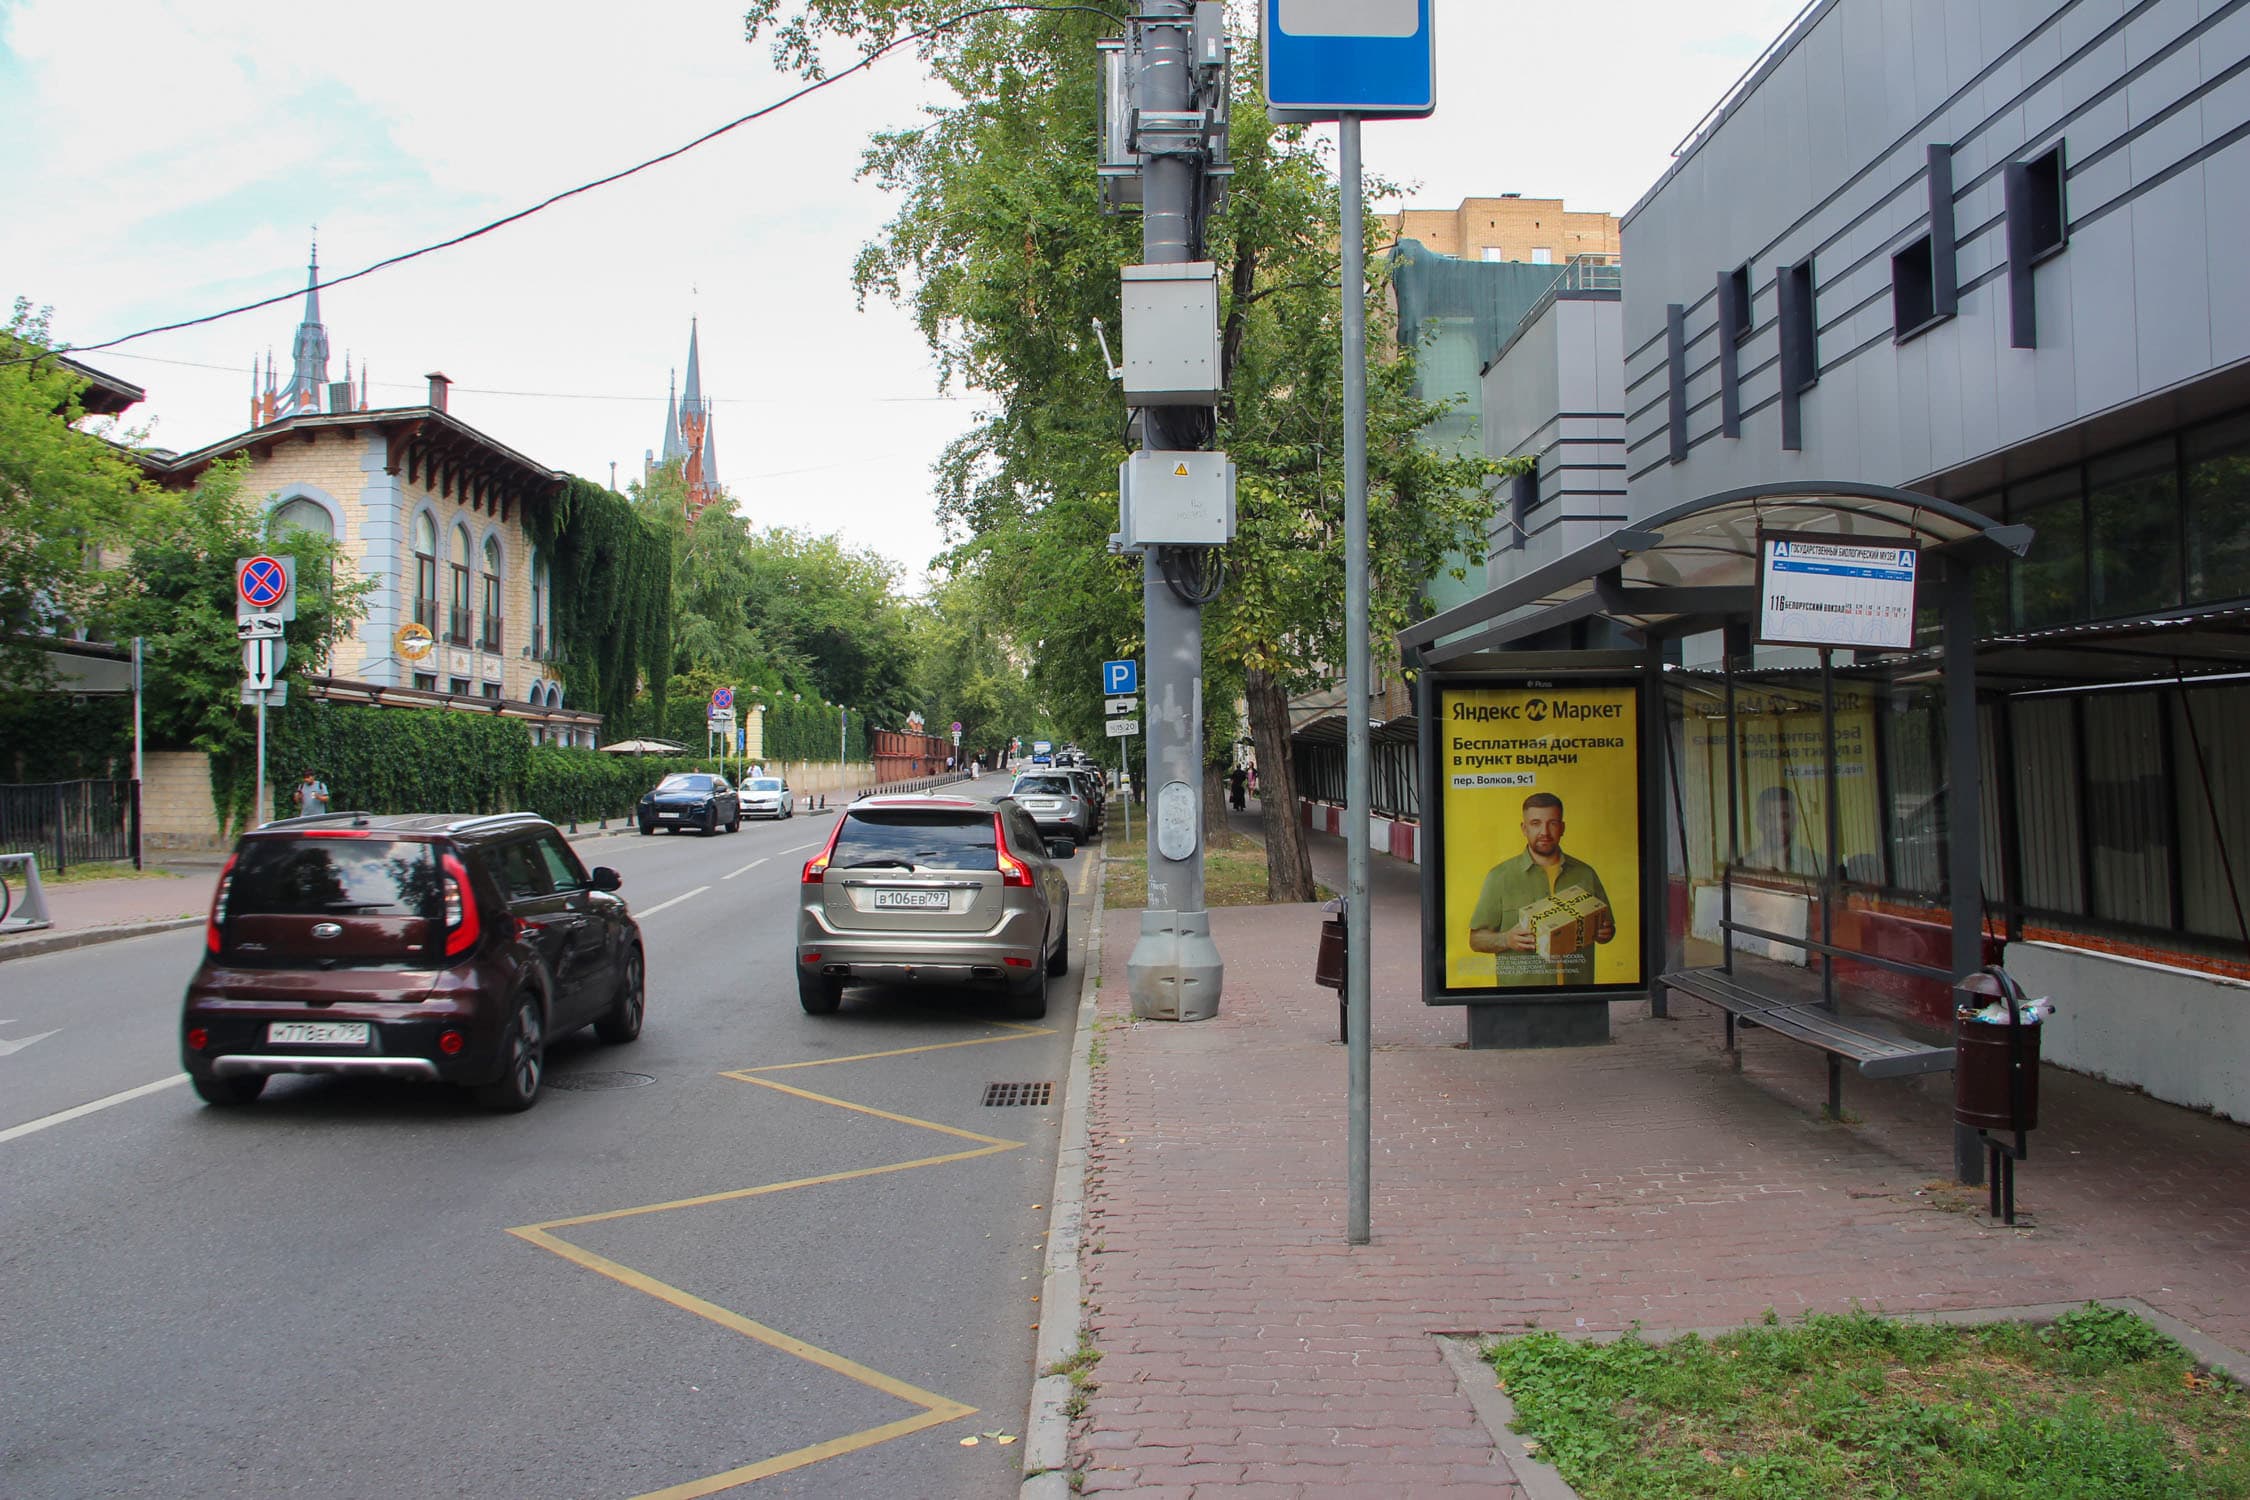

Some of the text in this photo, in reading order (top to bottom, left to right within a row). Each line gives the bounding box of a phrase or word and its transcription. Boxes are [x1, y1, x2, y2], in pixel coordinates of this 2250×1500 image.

[1770, 594, 1785, 611] 116
[1112, 665, 1129, 690] P
[1453, 702, 1521, 722] Яндекс
[1552, 701, 1623, 721] Маркет
[1453, 736, 1624, 751] Бесплатная доставка
[1453, 752, 1578, 768] в пункт выдачи
[1453, 774, 1534, 787] пер. Волков, 9с1
